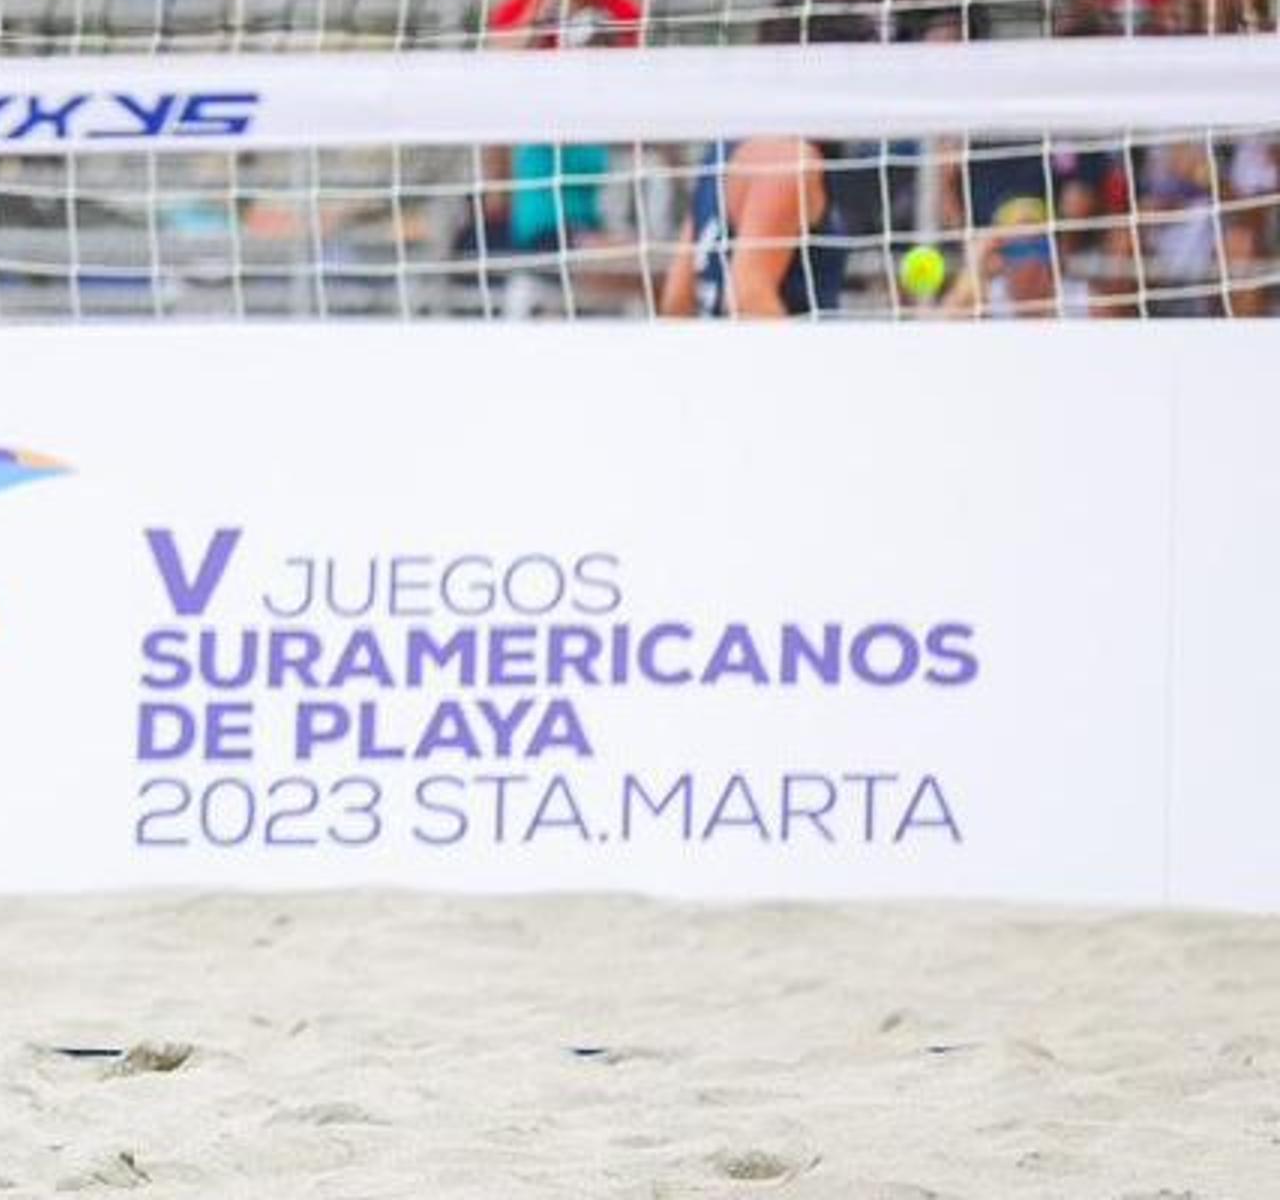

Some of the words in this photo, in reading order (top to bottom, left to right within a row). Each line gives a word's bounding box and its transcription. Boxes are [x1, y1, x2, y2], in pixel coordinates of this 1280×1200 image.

[143, 528, 242, 616] V
[261, 553, 622, 617] JUEGOS
[139, 623, 980, 690] SURAMERICANOS
[137, 702, 254, 761] DE
[295, 699, 594, 760] PLAYA
[135, 777, 382, 847] 2023
[412, 774, 963, 845] STA.MARTA
